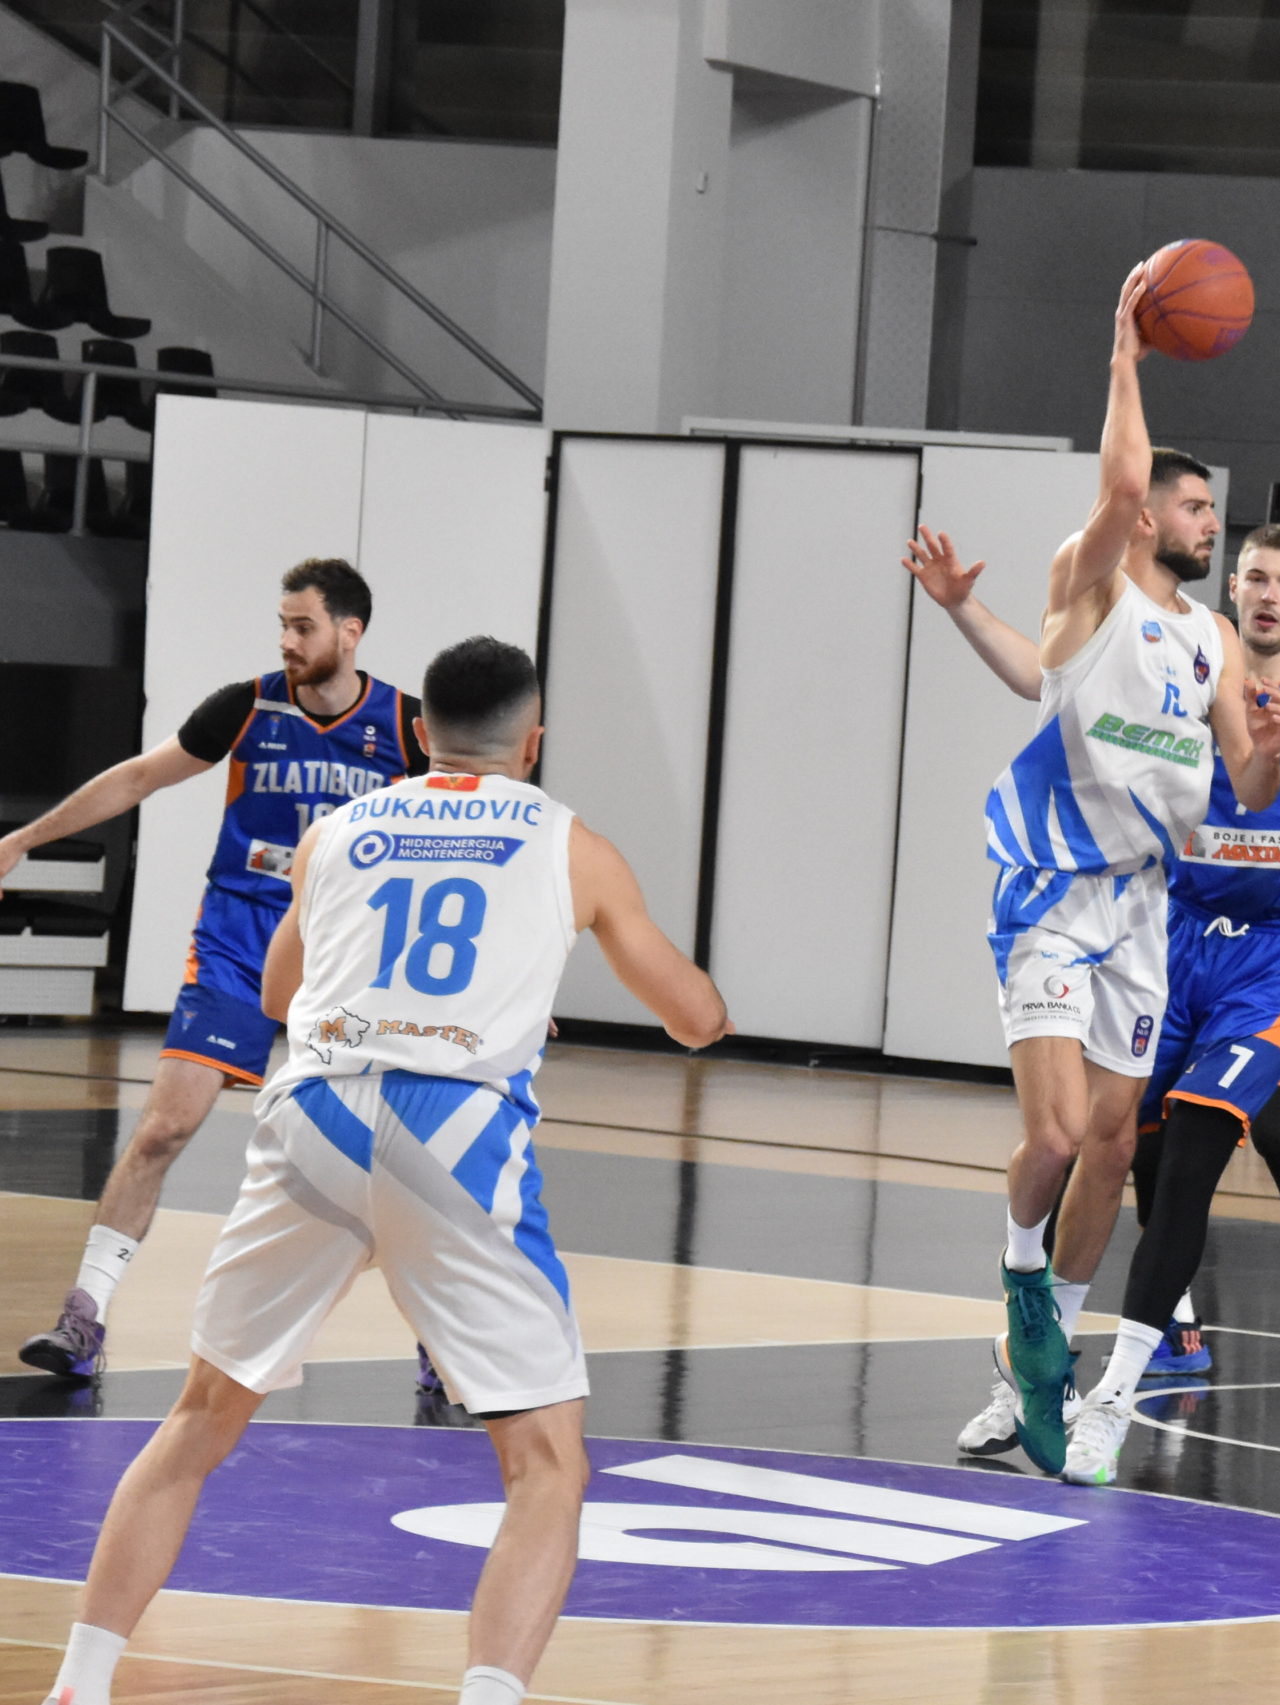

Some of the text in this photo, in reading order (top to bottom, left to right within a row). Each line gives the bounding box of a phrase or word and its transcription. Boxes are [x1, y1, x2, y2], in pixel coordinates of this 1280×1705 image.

[1213, 832, 1246, 843] BOJE
[399, 838, 505, 851] HIDROENERGIJA
[398, 848, 495, 861] MONTENEGRO
[366, 877, 488, 996] 18
[1218, 1044, 1255, 1089] 7
